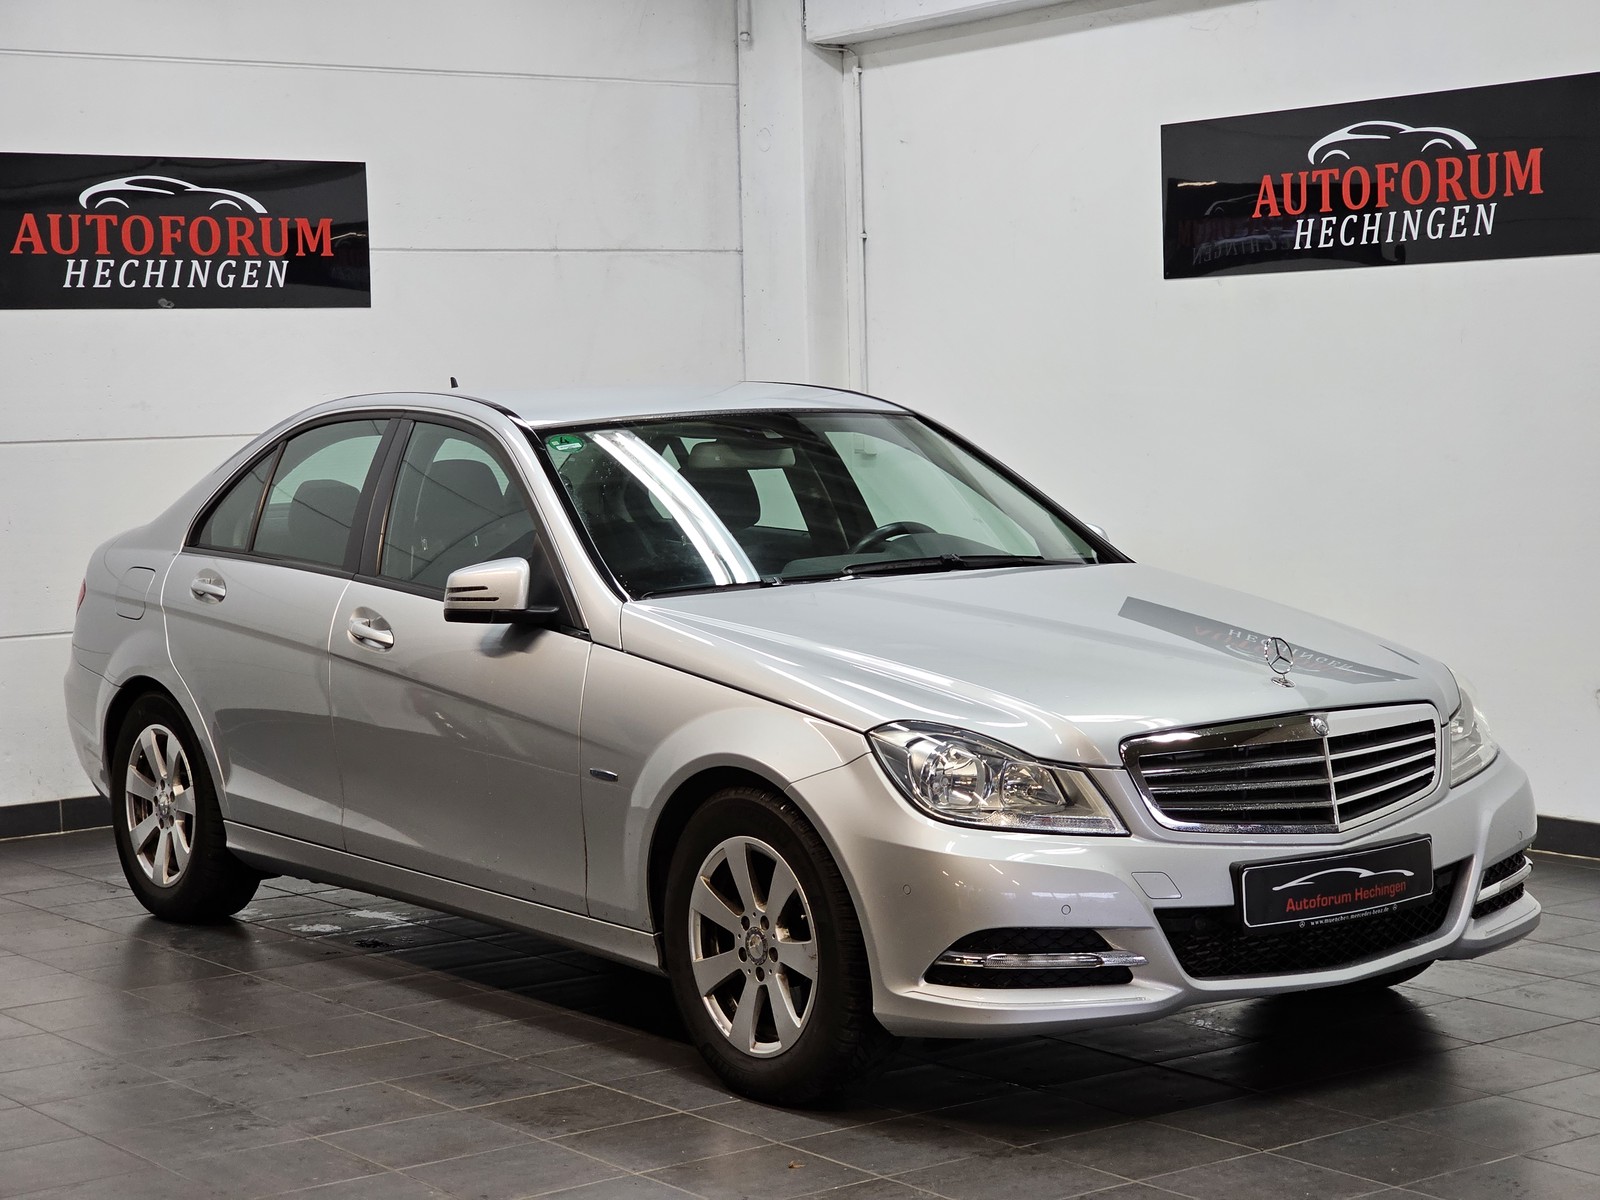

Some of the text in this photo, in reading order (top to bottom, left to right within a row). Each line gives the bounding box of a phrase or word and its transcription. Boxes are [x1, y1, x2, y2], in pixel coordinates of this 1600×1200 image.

[1252, 147, 1545, 218] AUTOFORUM
[10, 213, 334, 257] AUTOFORUM
[1294, 202, 1498, 250] HECHINGEN
[62, 260, 289, 288] HECHINGEN
[1286, 881, 1406, 912] Autoforum Hechingen
